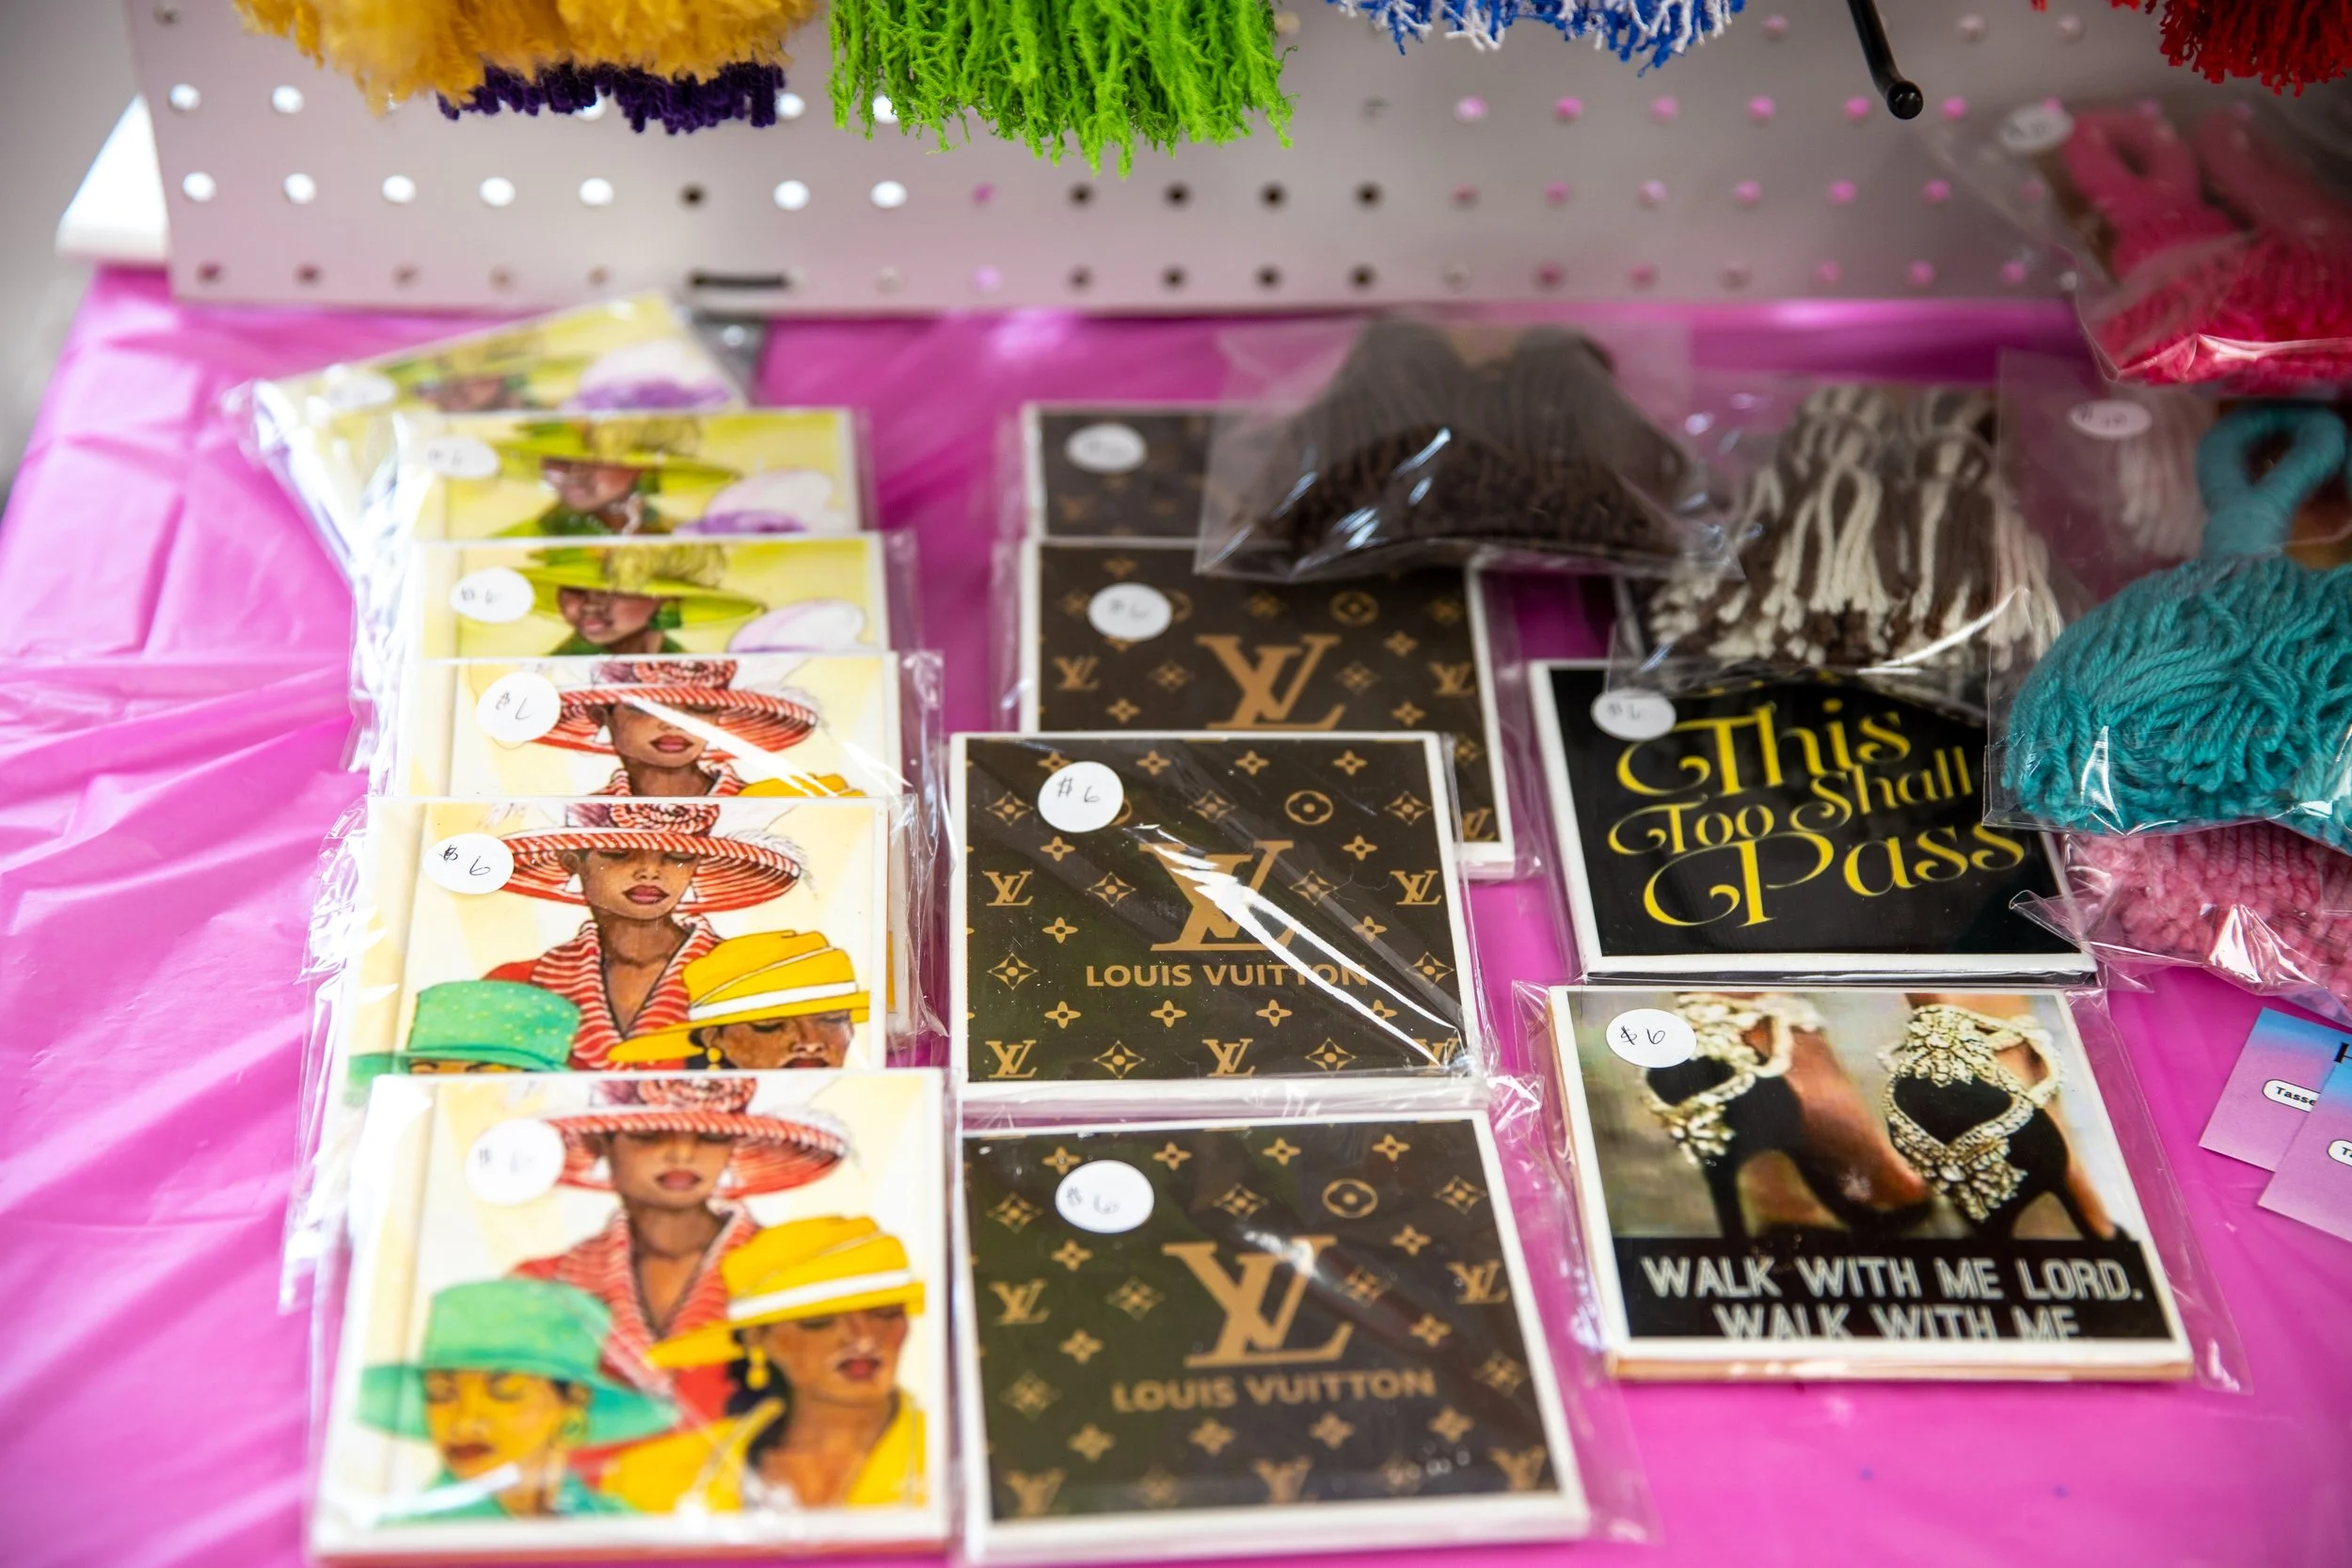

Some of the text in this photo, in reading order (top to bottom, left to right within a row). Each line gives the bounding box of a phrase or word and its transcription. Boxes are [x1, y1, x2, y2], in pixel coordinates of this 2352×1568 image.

[1196, 635, 1346, 731] LV
[1616, 698, 1912, 797] This
[1789, 746, 1974, 832] Shall
[1607, 795, 1776, 856] Too
[984, 870, 1034, 906] LV
[1138, 840, 1300, 951] LV
[1390, 869, 1442, 906] LV
[1644, 822, 2026, 928] Pass
[1086, 963, 1369, 988] LOUIS VUITTON
[985, 1039, 1038, 1079] LV
[1202, 1037, 1257, 1078] LV
[1641, 1256, 2144, 1301] WALK WITH ME LORD.
[1162, 1235, 1353, 1368] LV
[1711, 1303, 1855, 1340] WALK
[1867, 1303, 2000, 1340] WITH
[1110, 1368, 1438, 1413] LOUIS VUITTON
